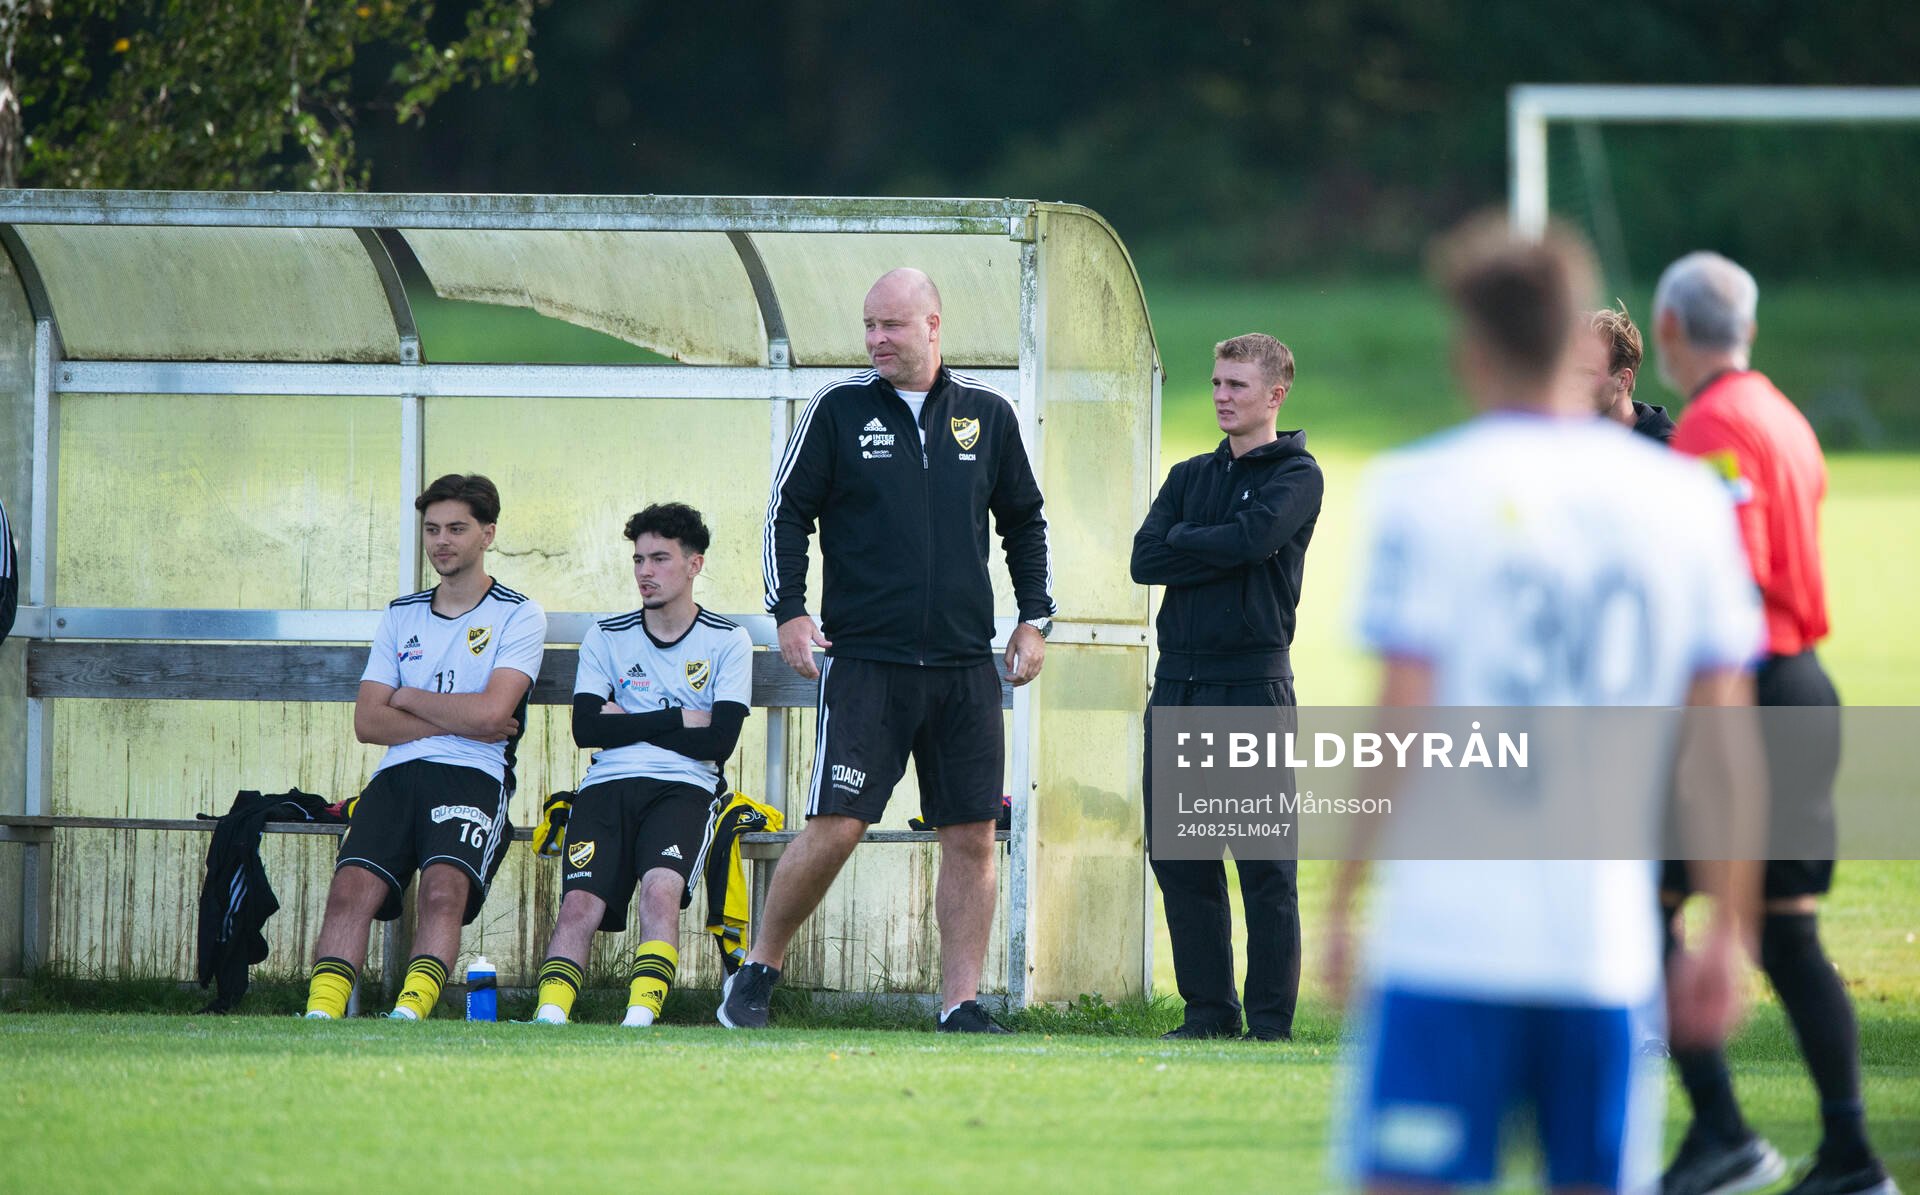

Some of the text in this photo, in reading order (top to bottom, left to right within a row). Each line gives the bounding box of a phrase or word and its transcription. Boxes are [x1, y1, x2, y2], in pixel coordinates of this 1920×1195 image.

[435, 670, 454, 693] 13
[831, 764, 866, 788] COACH
[460, 822, 483, 848] 16
